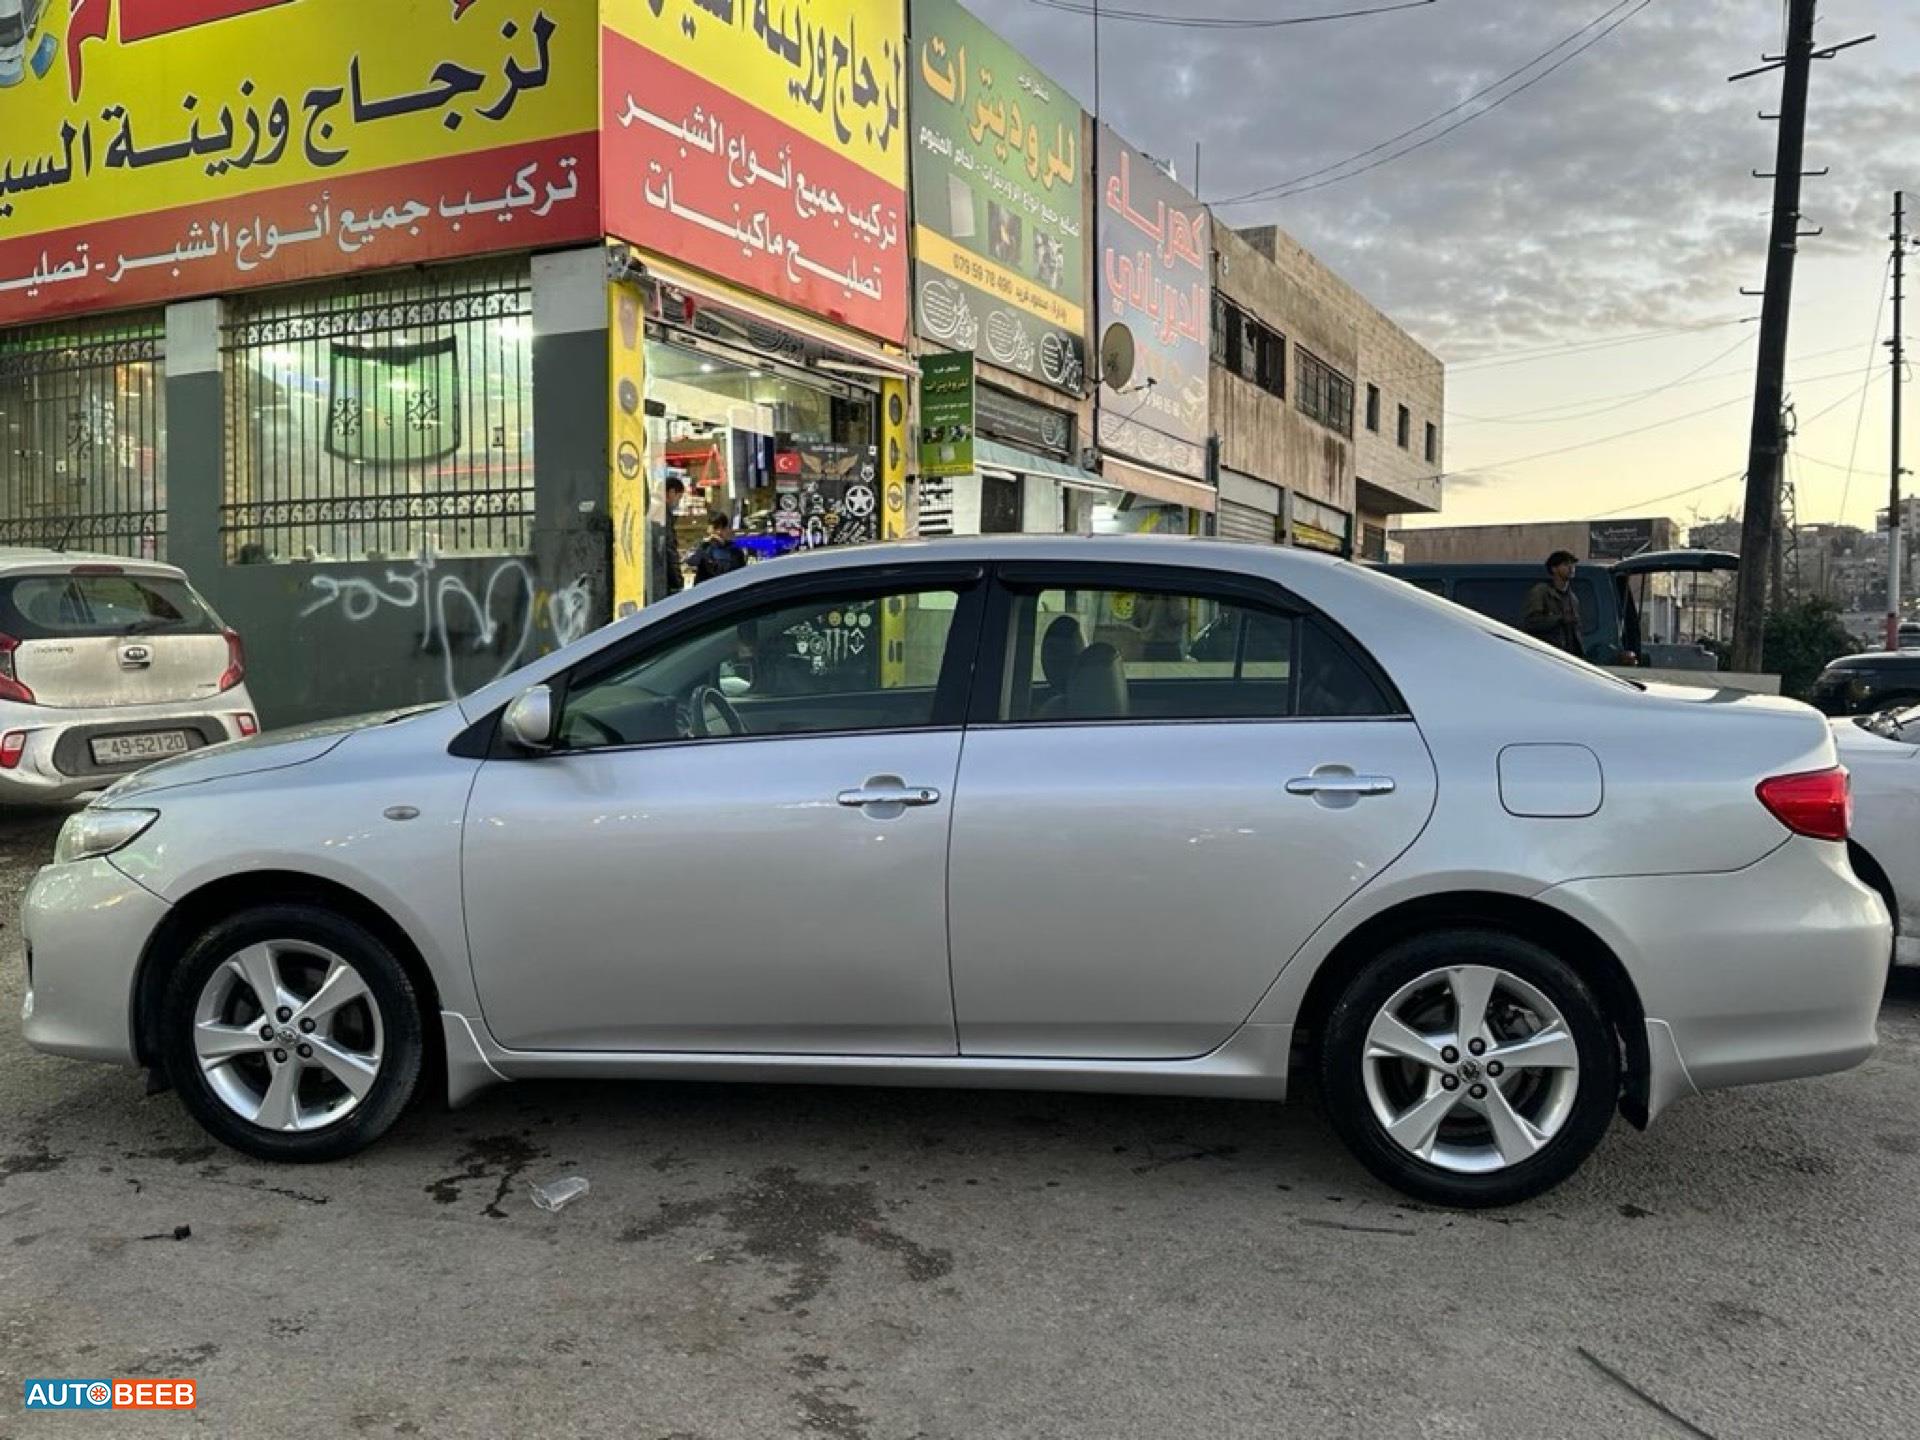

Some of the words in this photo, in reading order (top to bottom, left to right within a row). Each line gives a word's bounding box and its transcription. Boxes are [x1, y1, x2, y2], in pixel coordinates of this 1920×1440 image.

[302, 10, 556, 166] لزجاج
[832, 15, 900, 152] لزجاج
[104, 79, 291, 175] وزينة
[616, 92, 725, 158] الشبر
[726, 133, 794, 189] أنواع
[337, 199, 430, 254] جميع
[439, 156, 579, 235] تركيب
[643, 160, 783, 257] ماكينات
[795, 171, 845, 228] جميع
[846, 203, 898, 251] تركيب
[105, 221, 230, 278] الشبر
[234, 191, 332, 271] أنواع
[785, 236, 882, 301] تصليح
